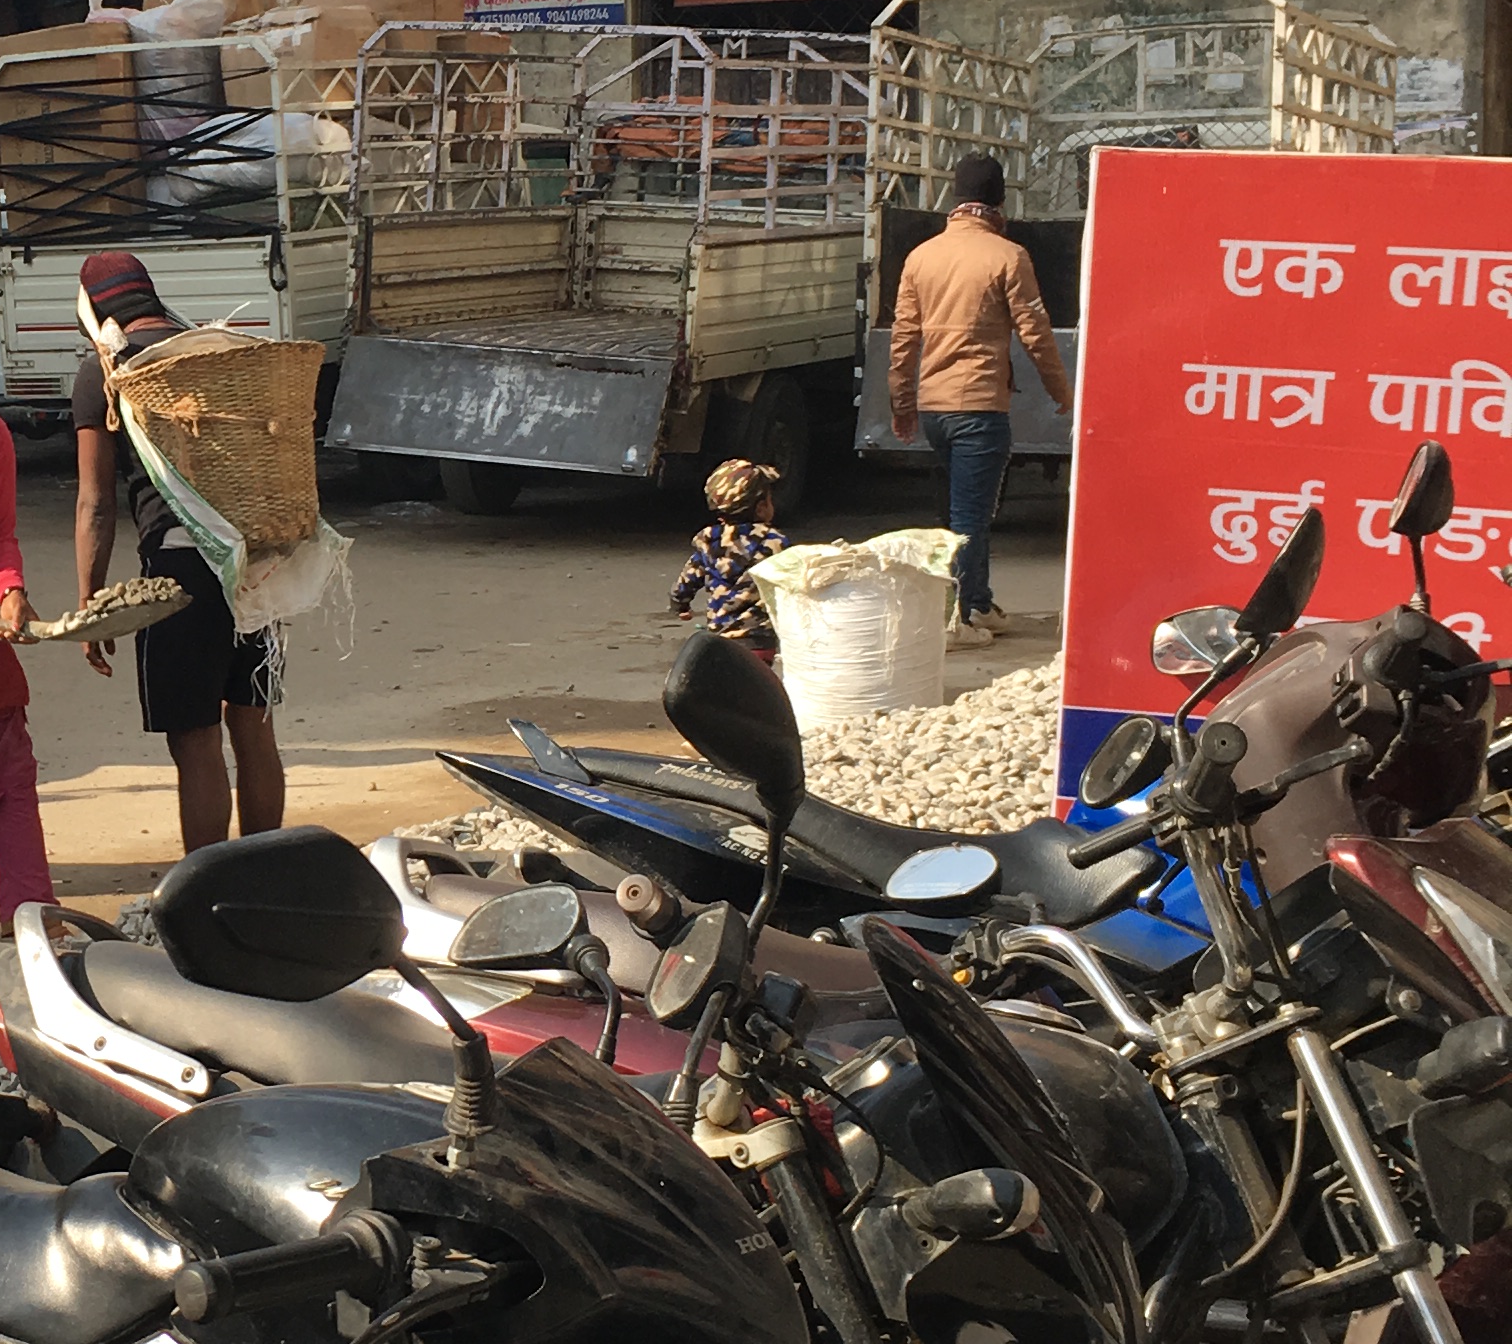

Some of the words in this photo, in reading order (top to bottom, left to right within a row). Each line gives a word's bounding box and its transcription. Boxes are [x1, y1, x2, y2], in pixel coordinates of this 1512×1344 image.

[546, 7, 610, 24] 9041498244
[1219, 238, 1356, 299] एक
[1181, 362, 1336, 429] मात्र
